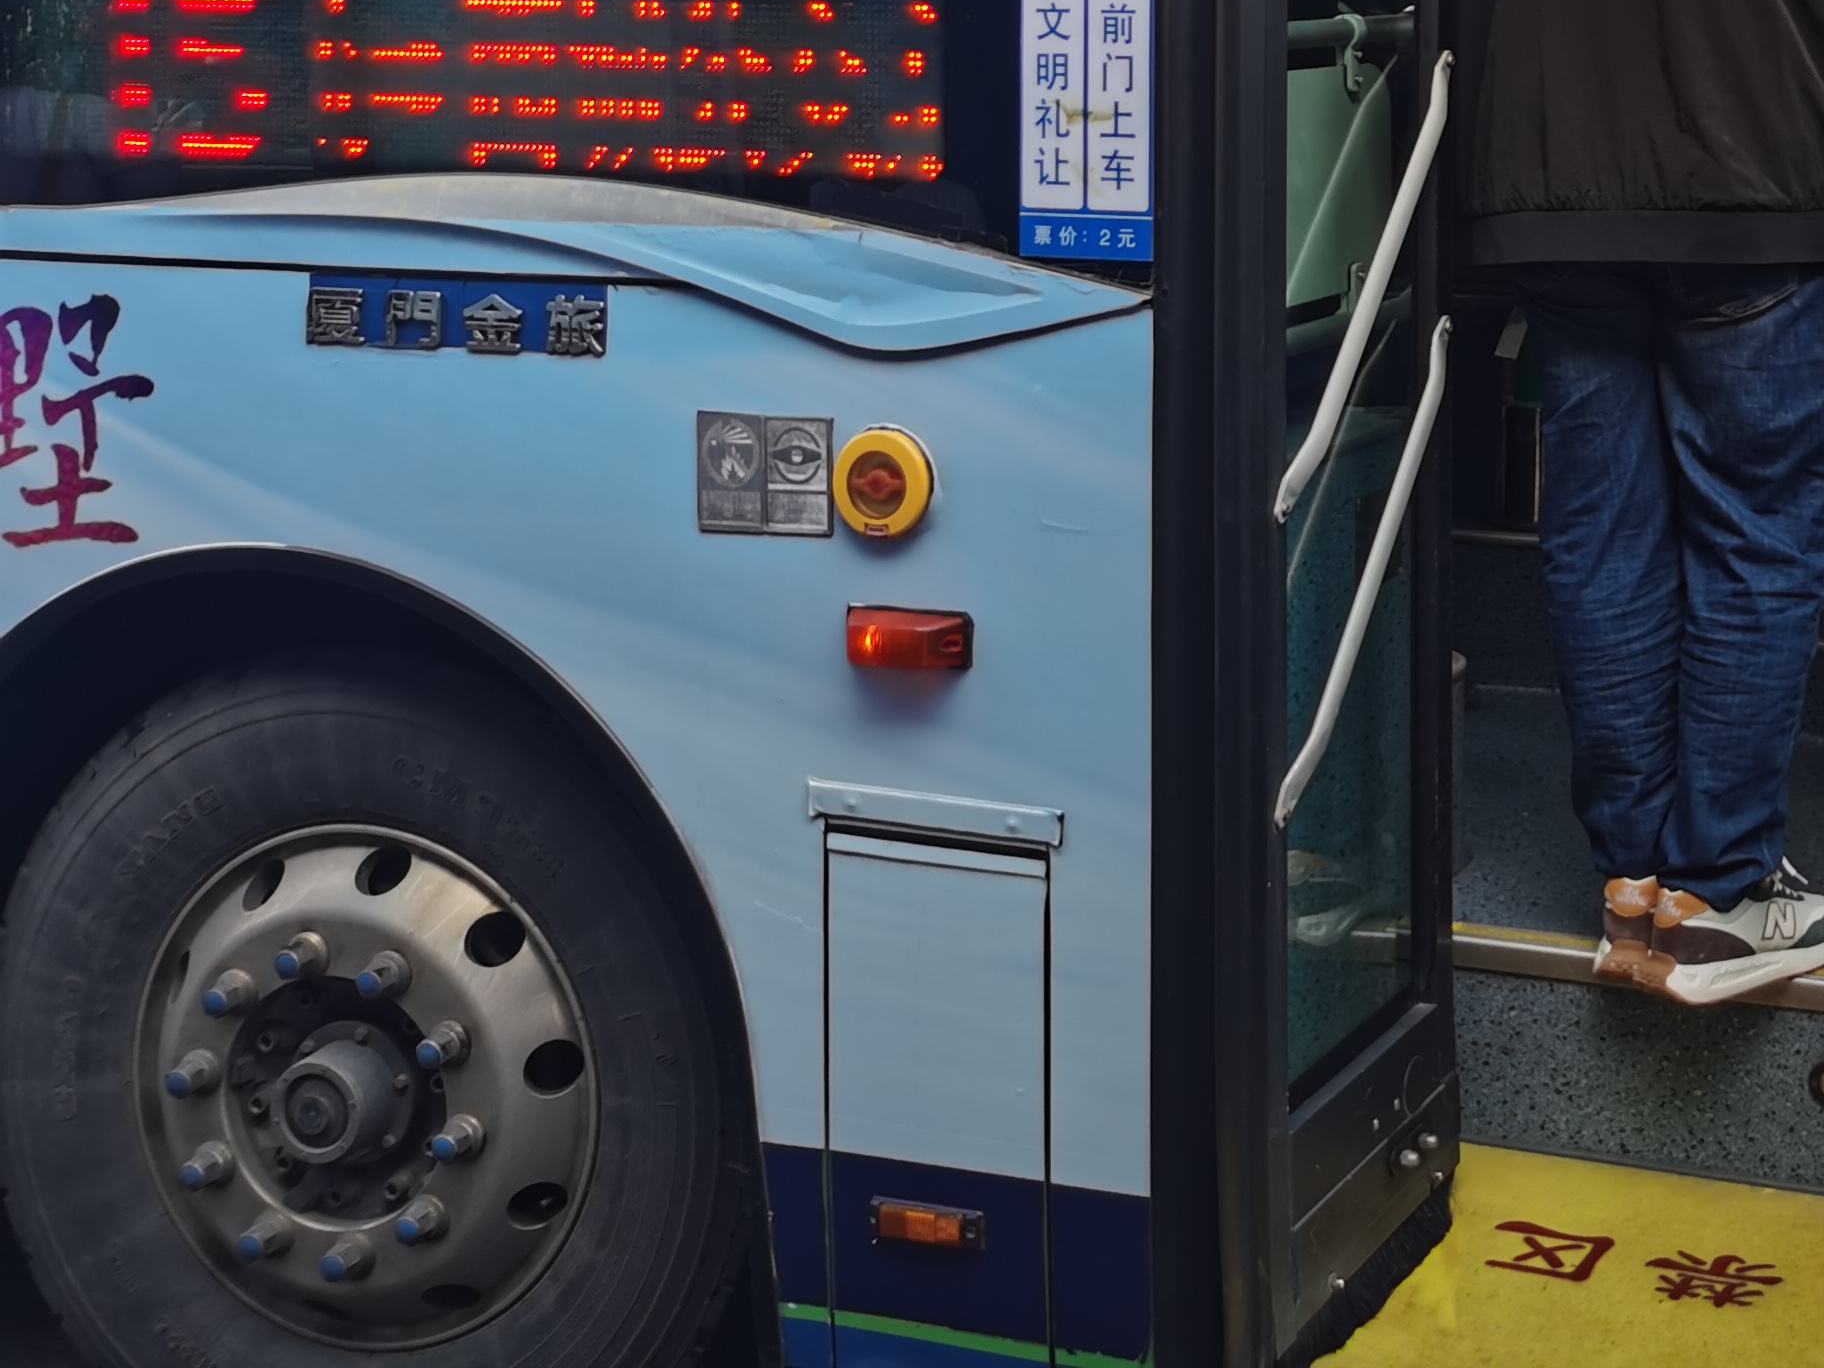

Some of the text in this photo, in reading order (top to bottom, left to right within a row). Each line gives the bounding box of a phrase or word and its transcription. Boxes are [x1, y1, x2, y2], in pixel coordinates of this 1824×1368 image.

[1033, 3, 1071, 187] 文明礼让
[1100, 3, 1136, 191] 前门上车
